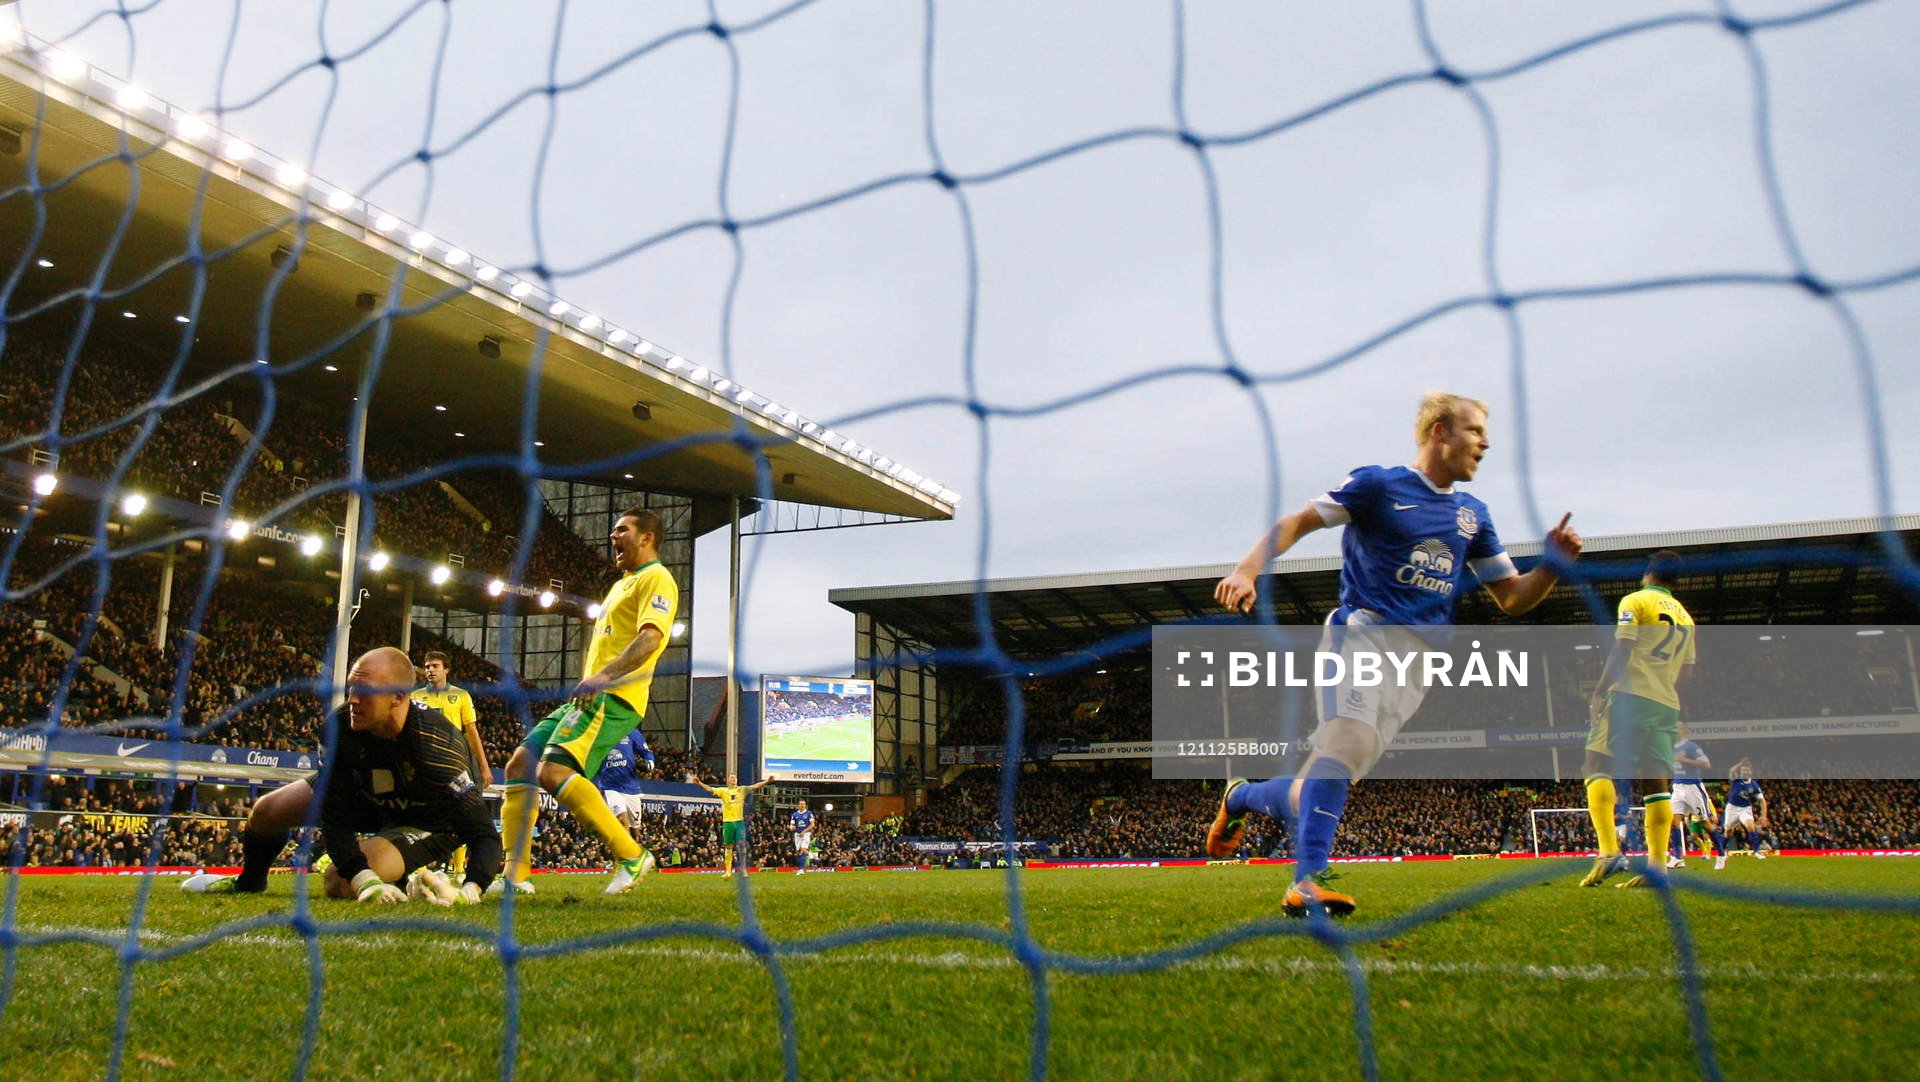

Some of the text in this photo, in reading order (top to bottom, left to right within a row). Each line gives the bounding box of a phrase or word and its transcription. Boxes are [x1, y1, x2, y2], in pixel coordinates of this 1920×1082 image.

[1651, 613, 1689, 660] 27
[1800, 723, 1818, 731] NOT
[1822, 720, 1900, 730] MANUFACTURED
[1450, 735, 1473, 743] CLUB
[1091, 745, 1106, 754] AND
[1108, 745, 1115, 753] IF
[1117, 745, 1132, 753] YOU
[247, 750, 279, 768] Chang
[605, 759, 628, 769] Chang
[793, 772, 845, 780] evertonfc.com
[915, 842, 957, 851] Thomas Cook
